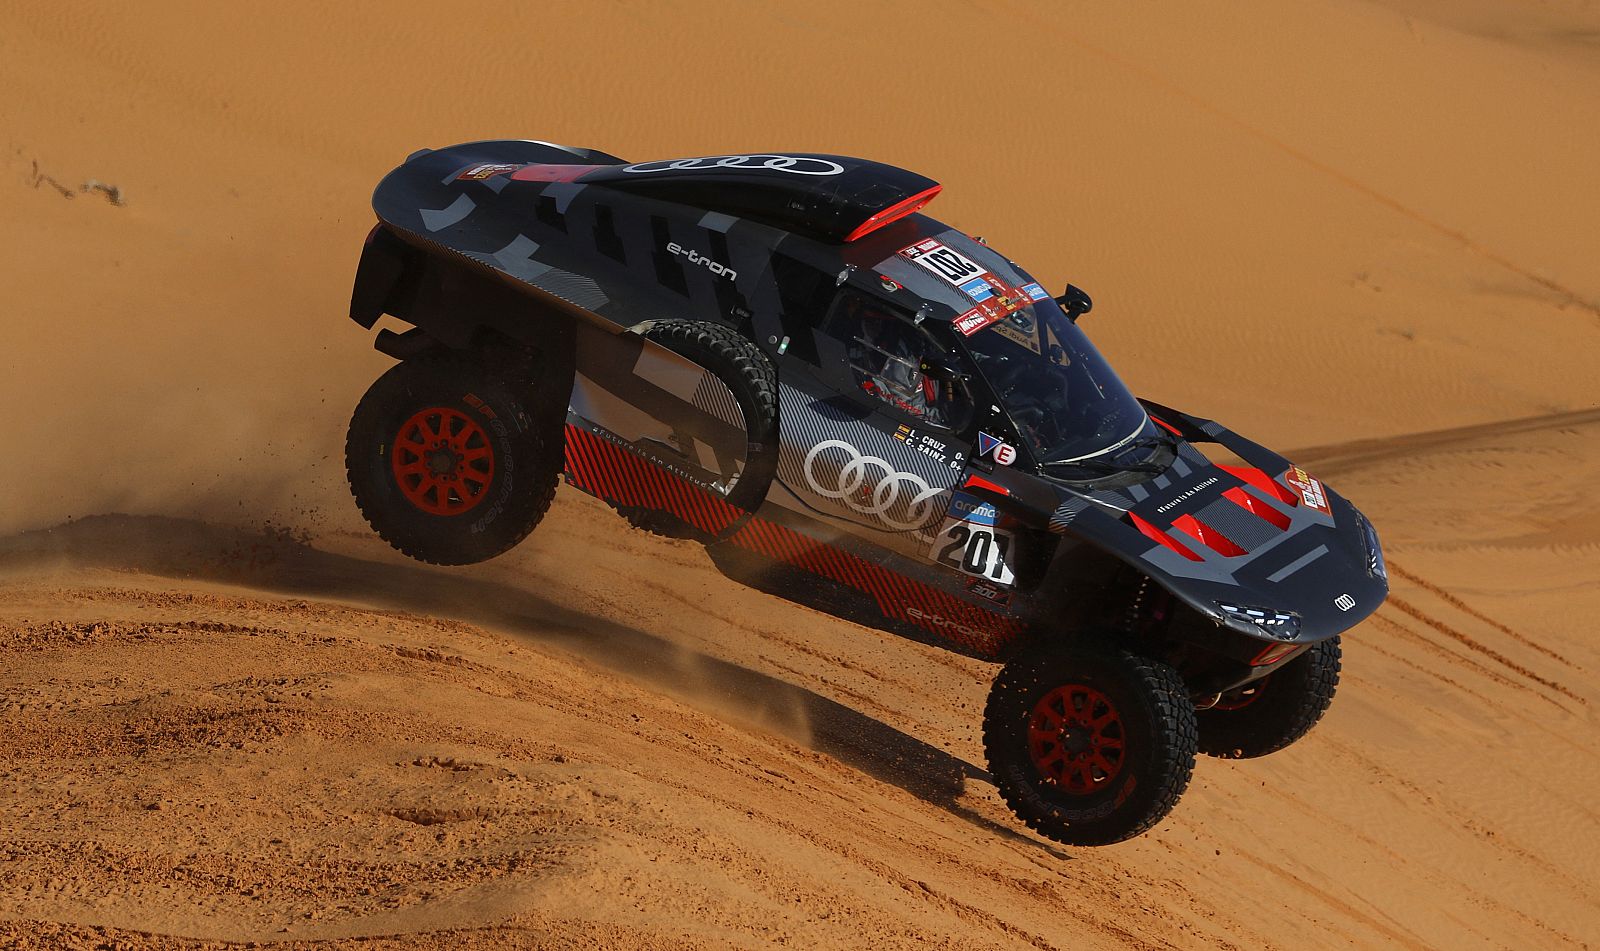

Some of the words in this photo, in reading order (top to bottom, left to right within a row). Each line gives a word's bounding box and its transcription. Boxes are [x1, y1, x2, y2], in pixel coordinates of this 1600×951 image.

[666, 242, 737, 281] e-tron
[922, 249, 978, 282] 207
[905, 438, 915, 448] C.
[917, 444, 947, 463] SAINZ
[909, 429, 919, 440] L.
[922, 435, 947, 452] CRUZ
[997, 446, 1012, 463] E
[667, 464, 711, 490] Attitud
[955, 500, 1001, 520] aramco
[906, 607, 990, 642] e-tron
